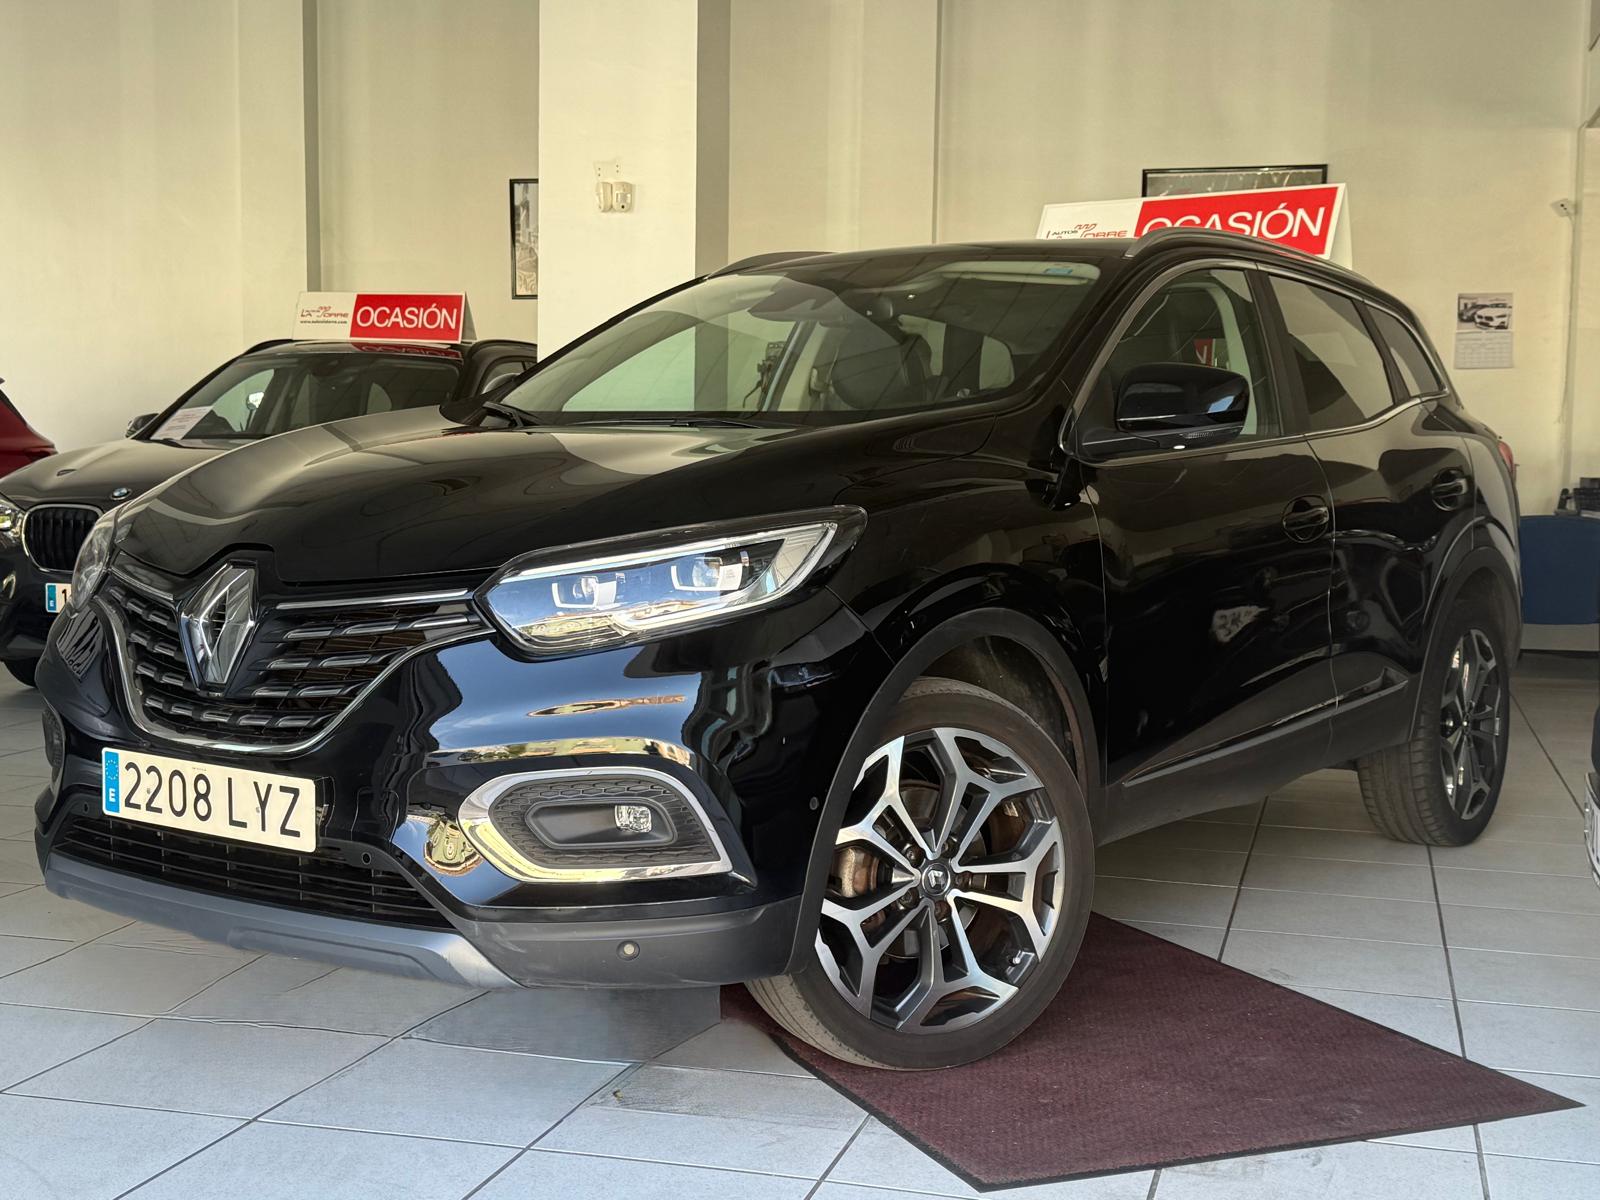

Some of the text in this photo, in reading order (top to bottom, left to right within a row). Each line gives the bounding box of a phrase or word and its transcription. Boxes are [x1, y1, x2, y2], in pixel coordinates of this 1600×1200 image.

[356, 303, 458, 330] OCASIÓN
[108, 787, 117, 803] E
[124, 761, 301, 838] 2208 LYZ
